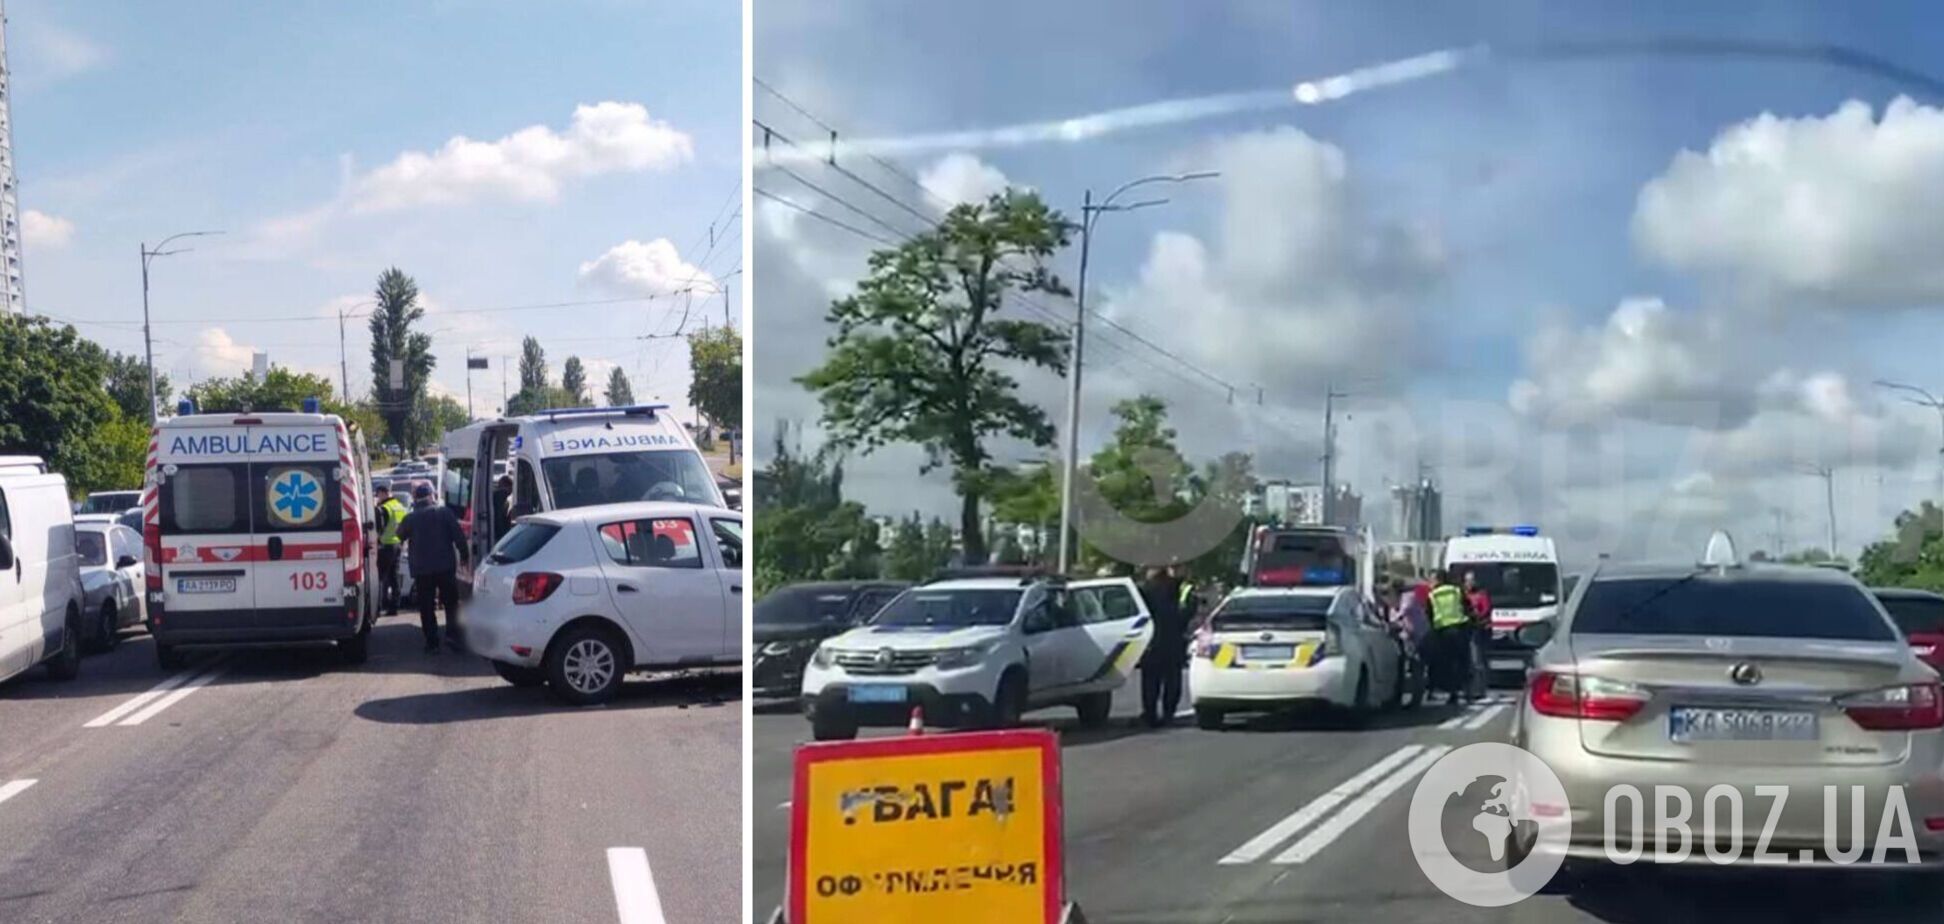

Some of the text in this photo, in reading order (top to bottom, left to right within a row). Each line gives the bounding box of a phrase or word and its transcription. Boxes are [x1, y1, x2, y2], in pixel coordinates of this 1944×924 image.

[170, 434, 327, 455] AMBULANCE
[289, 571, 328, 591] 103
[816, 861, 1037, 898] ОФРМЛЕННЯ
